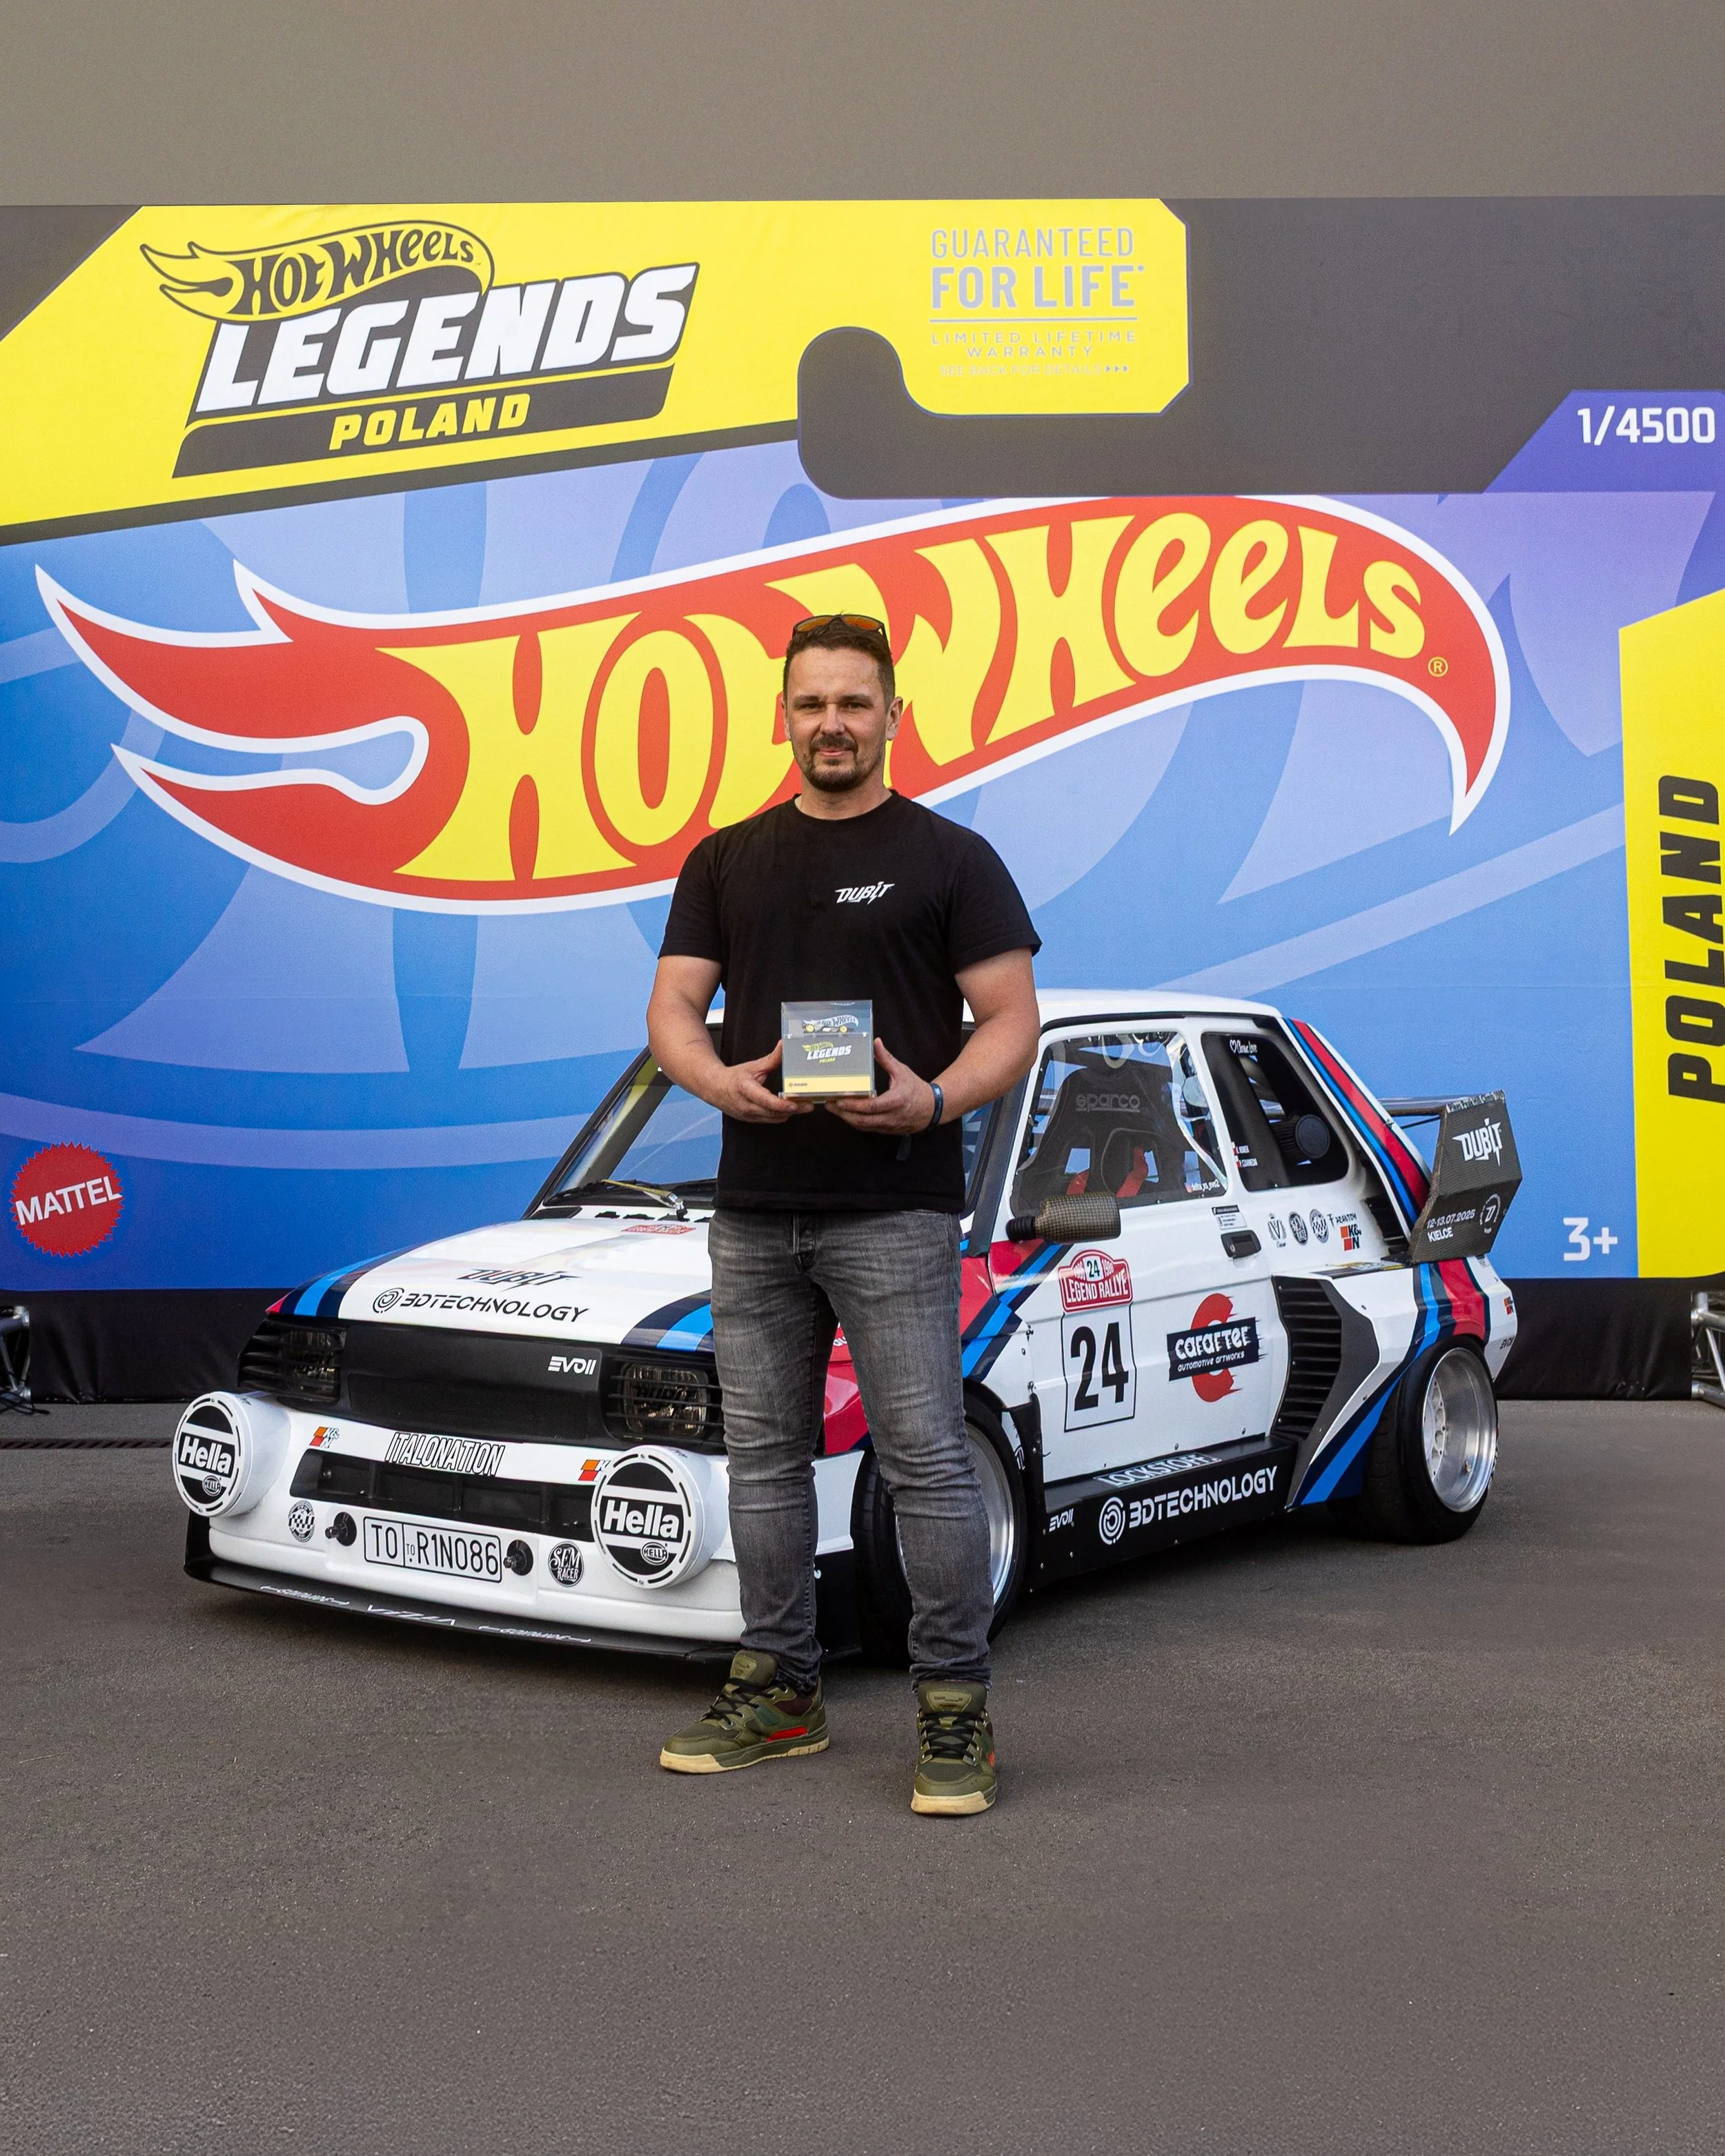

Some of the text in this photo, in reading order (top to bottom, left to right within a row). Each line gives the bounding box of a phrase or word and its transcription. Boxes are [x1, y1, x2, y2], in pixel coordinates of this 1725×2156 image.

[931, 228, 1134, 259] GUARANTEED
[931, 266, 1017, 308] FOR
[195, 264, 698, 413] LEGENDS
[931, 330, 1136, 344] LIMITED LIFETIME
[967, 346, 1093, 357] WARRANTY
[939, 364, 1102, 375] SEE BACK FOR DETAILS
[328, 393, 531, 451] POLAND
[1577, 405, 1715, 446] 1/4500
[1657, 774, 1725, 1104] POLAND
[806, 1045, 852, 1060] LEGENDS
[1076, 1094, 1141, 1113] sparco
[14, 1175, 123, 1226] MATTEL
[1427, 1209, 1476, 1229] 12-13.07.2025
[1427, 1227, 1454, 1243] KIELCE
[1562, 1216, 1618, 1261] 3+
[1063, 1267, 1129, 1303] LEGEND RALLYE
[1086, 1259, 1101, 1278] 24
[400, 1292, 590, 1323] 3DTECHNOLOGY
[1070, 1321, 1130, 1412] 24
[1177, 1350, 1245, 1372] automotive artworks
[179, 1435, 232, 1474] Hella
[384, 1431, 506, 1476] ITALONATION
[204, 1480, 221, 1490] HELLA
[1129, 1466, 1278, 1529] 3DTECHNOLOGY
[603, 1499, 680, 1539] Hella
[371, 1523, 399, 1559] TO
[643, 1548, 669, 1559] HELLA
[556, 1567, 580, 1581] RACER
